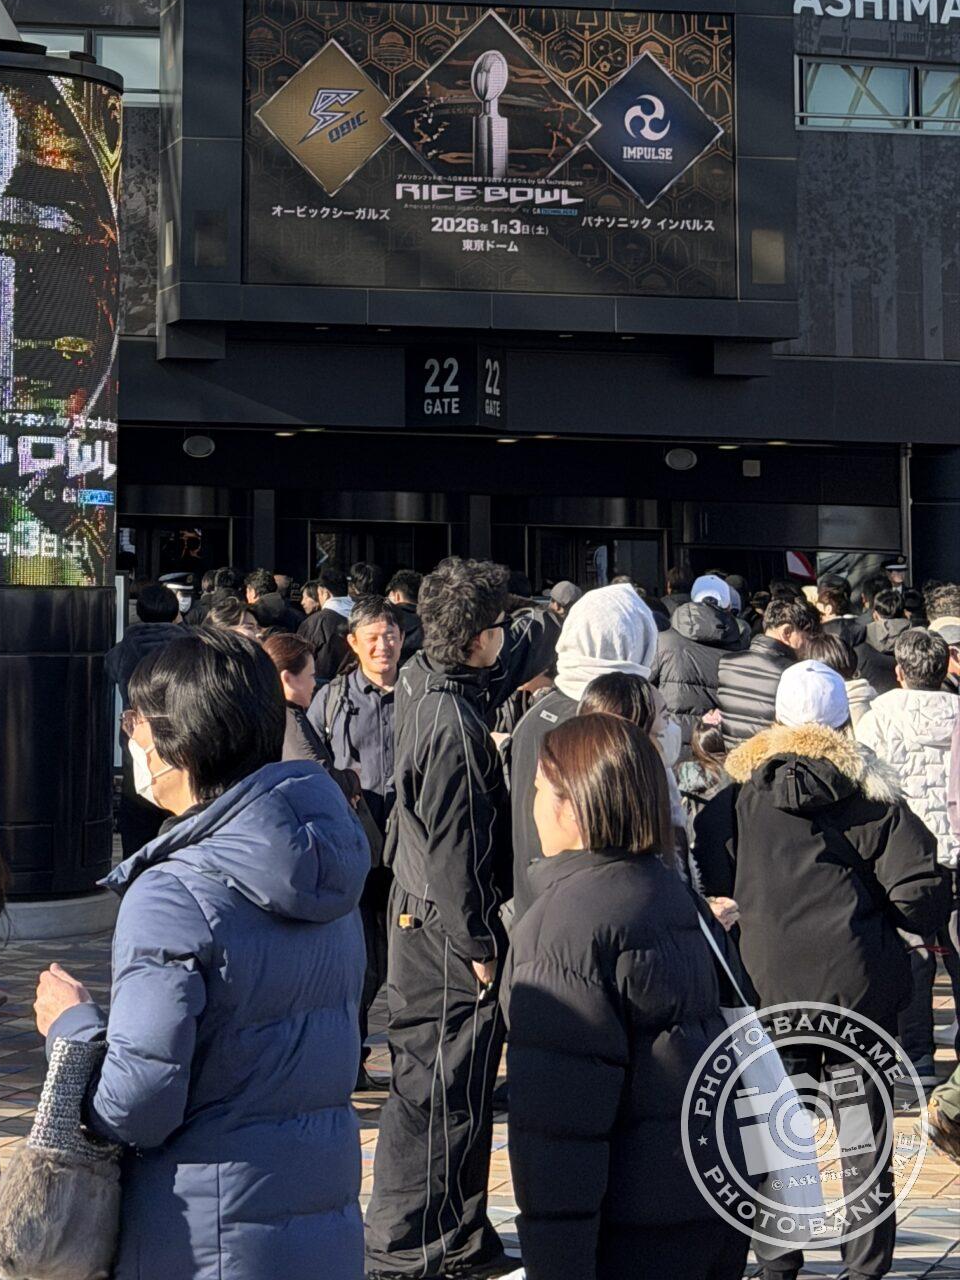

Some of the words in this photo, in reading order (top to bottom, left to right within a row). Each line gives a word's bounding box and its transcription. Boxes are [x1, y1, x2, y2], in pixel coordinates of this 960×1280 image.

[327, 110, 369, 144] OBIC
[622, 146, 673, 160] IMPULSE
[396, 183, 477, 202] RICE
[484, 186, 584, 205] BOWL
[271, 205, 390, 220] オービックシーガルズ
[462, 239, 519, 252] 東京ドーム
[424, 357, 459, 393] 22
[485, 358, 500, 395] 22
[423, 398, 460, 414] GATE
[485, 399, 501, 417] GATE
